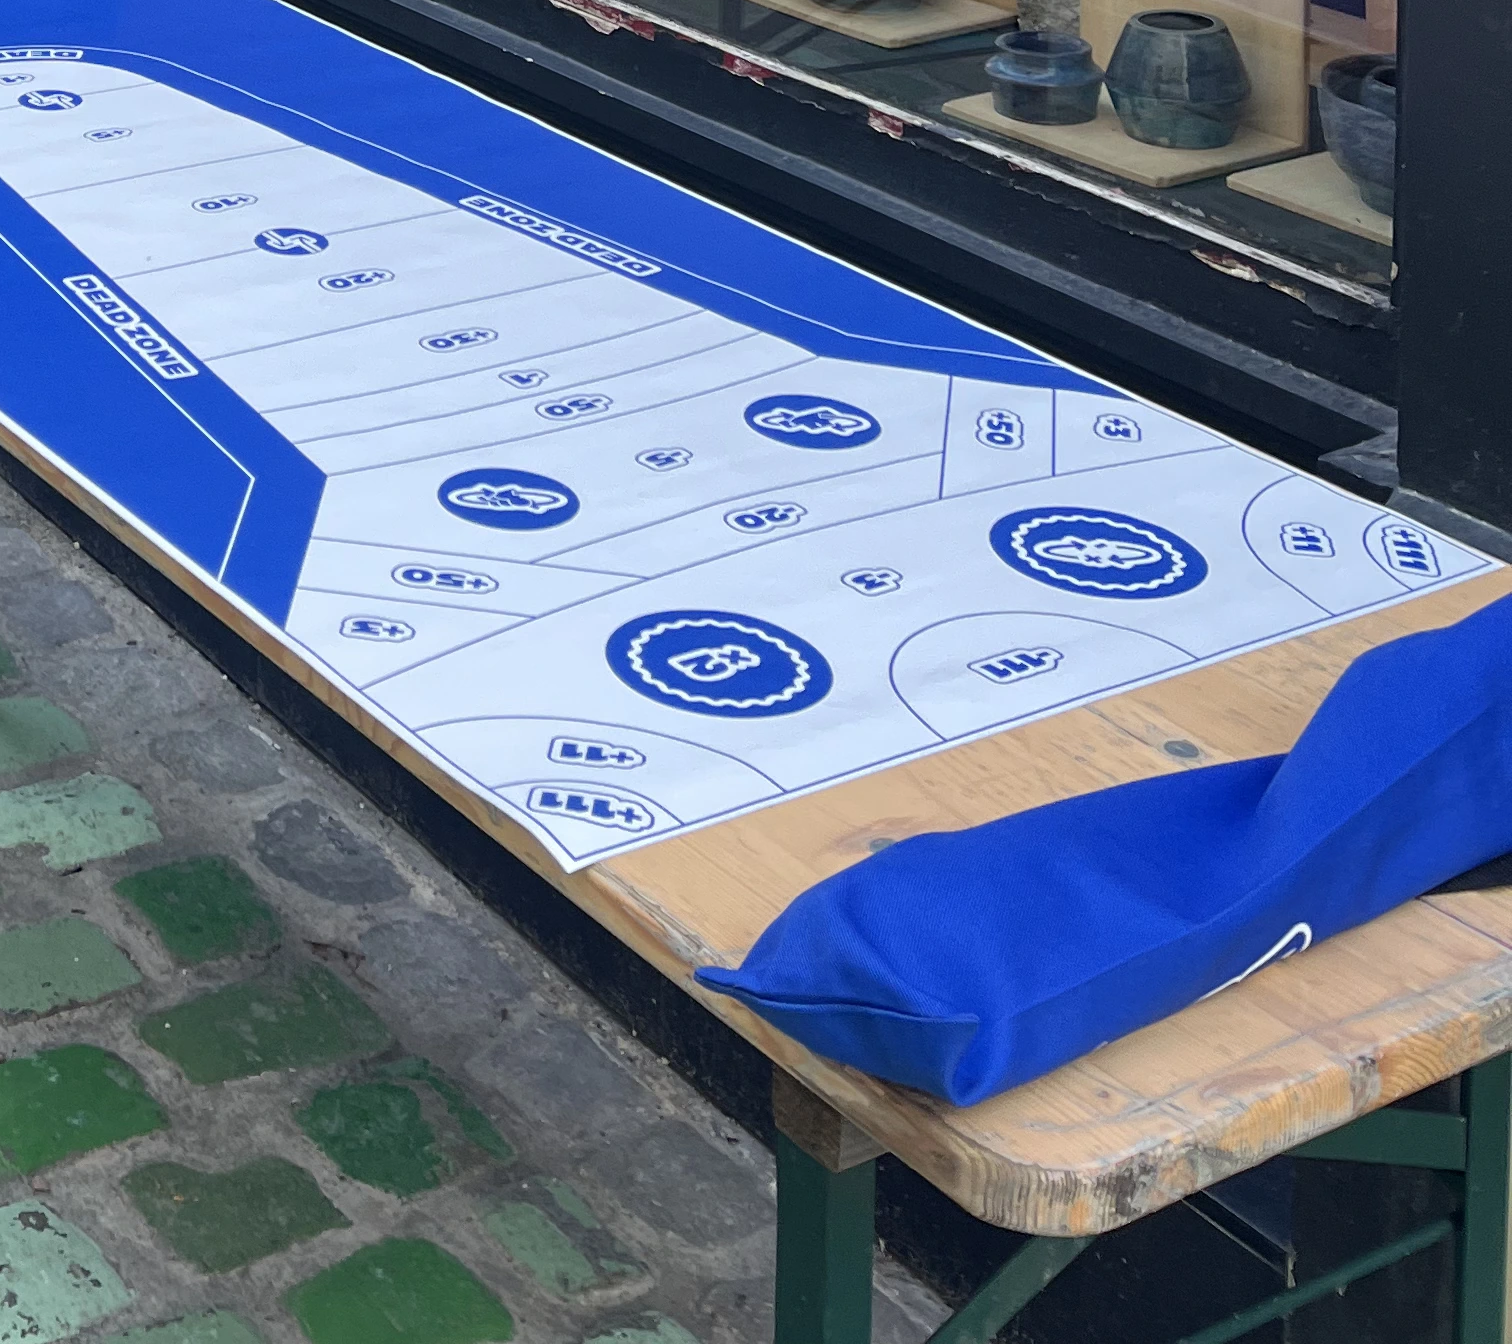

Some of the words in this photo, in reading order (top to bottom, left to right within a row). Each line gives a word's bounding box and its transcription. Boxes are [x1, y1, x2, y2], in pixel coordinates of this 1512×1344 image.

[465, 197, 556, 236] ZONE
[555, 233, 656, 275] DEAD
[326, 271, 387, 290] +20
[68, 276, 135, 325] DEAD
[121, 323, 193, 377] ZONE
[427, 330, 488, 349] +30
[543, 397, 604, 417] -50
[985, 411, 1015, 446] +50
[1102, 417, 1132, 439] +3
[733, 506, 797, 529] -20
[1290, 525, 1325, 554] +11
[1391, 528, 1431, 573] +111
[401, 567, 489, 590] +50
[850, 571, 892, 591] -3
[349, 619, 406, 638] +3
[978, 650, 1053, 680] -111
[558, 741, 636, 765] +11
[538, 790, 644, 825] +111
